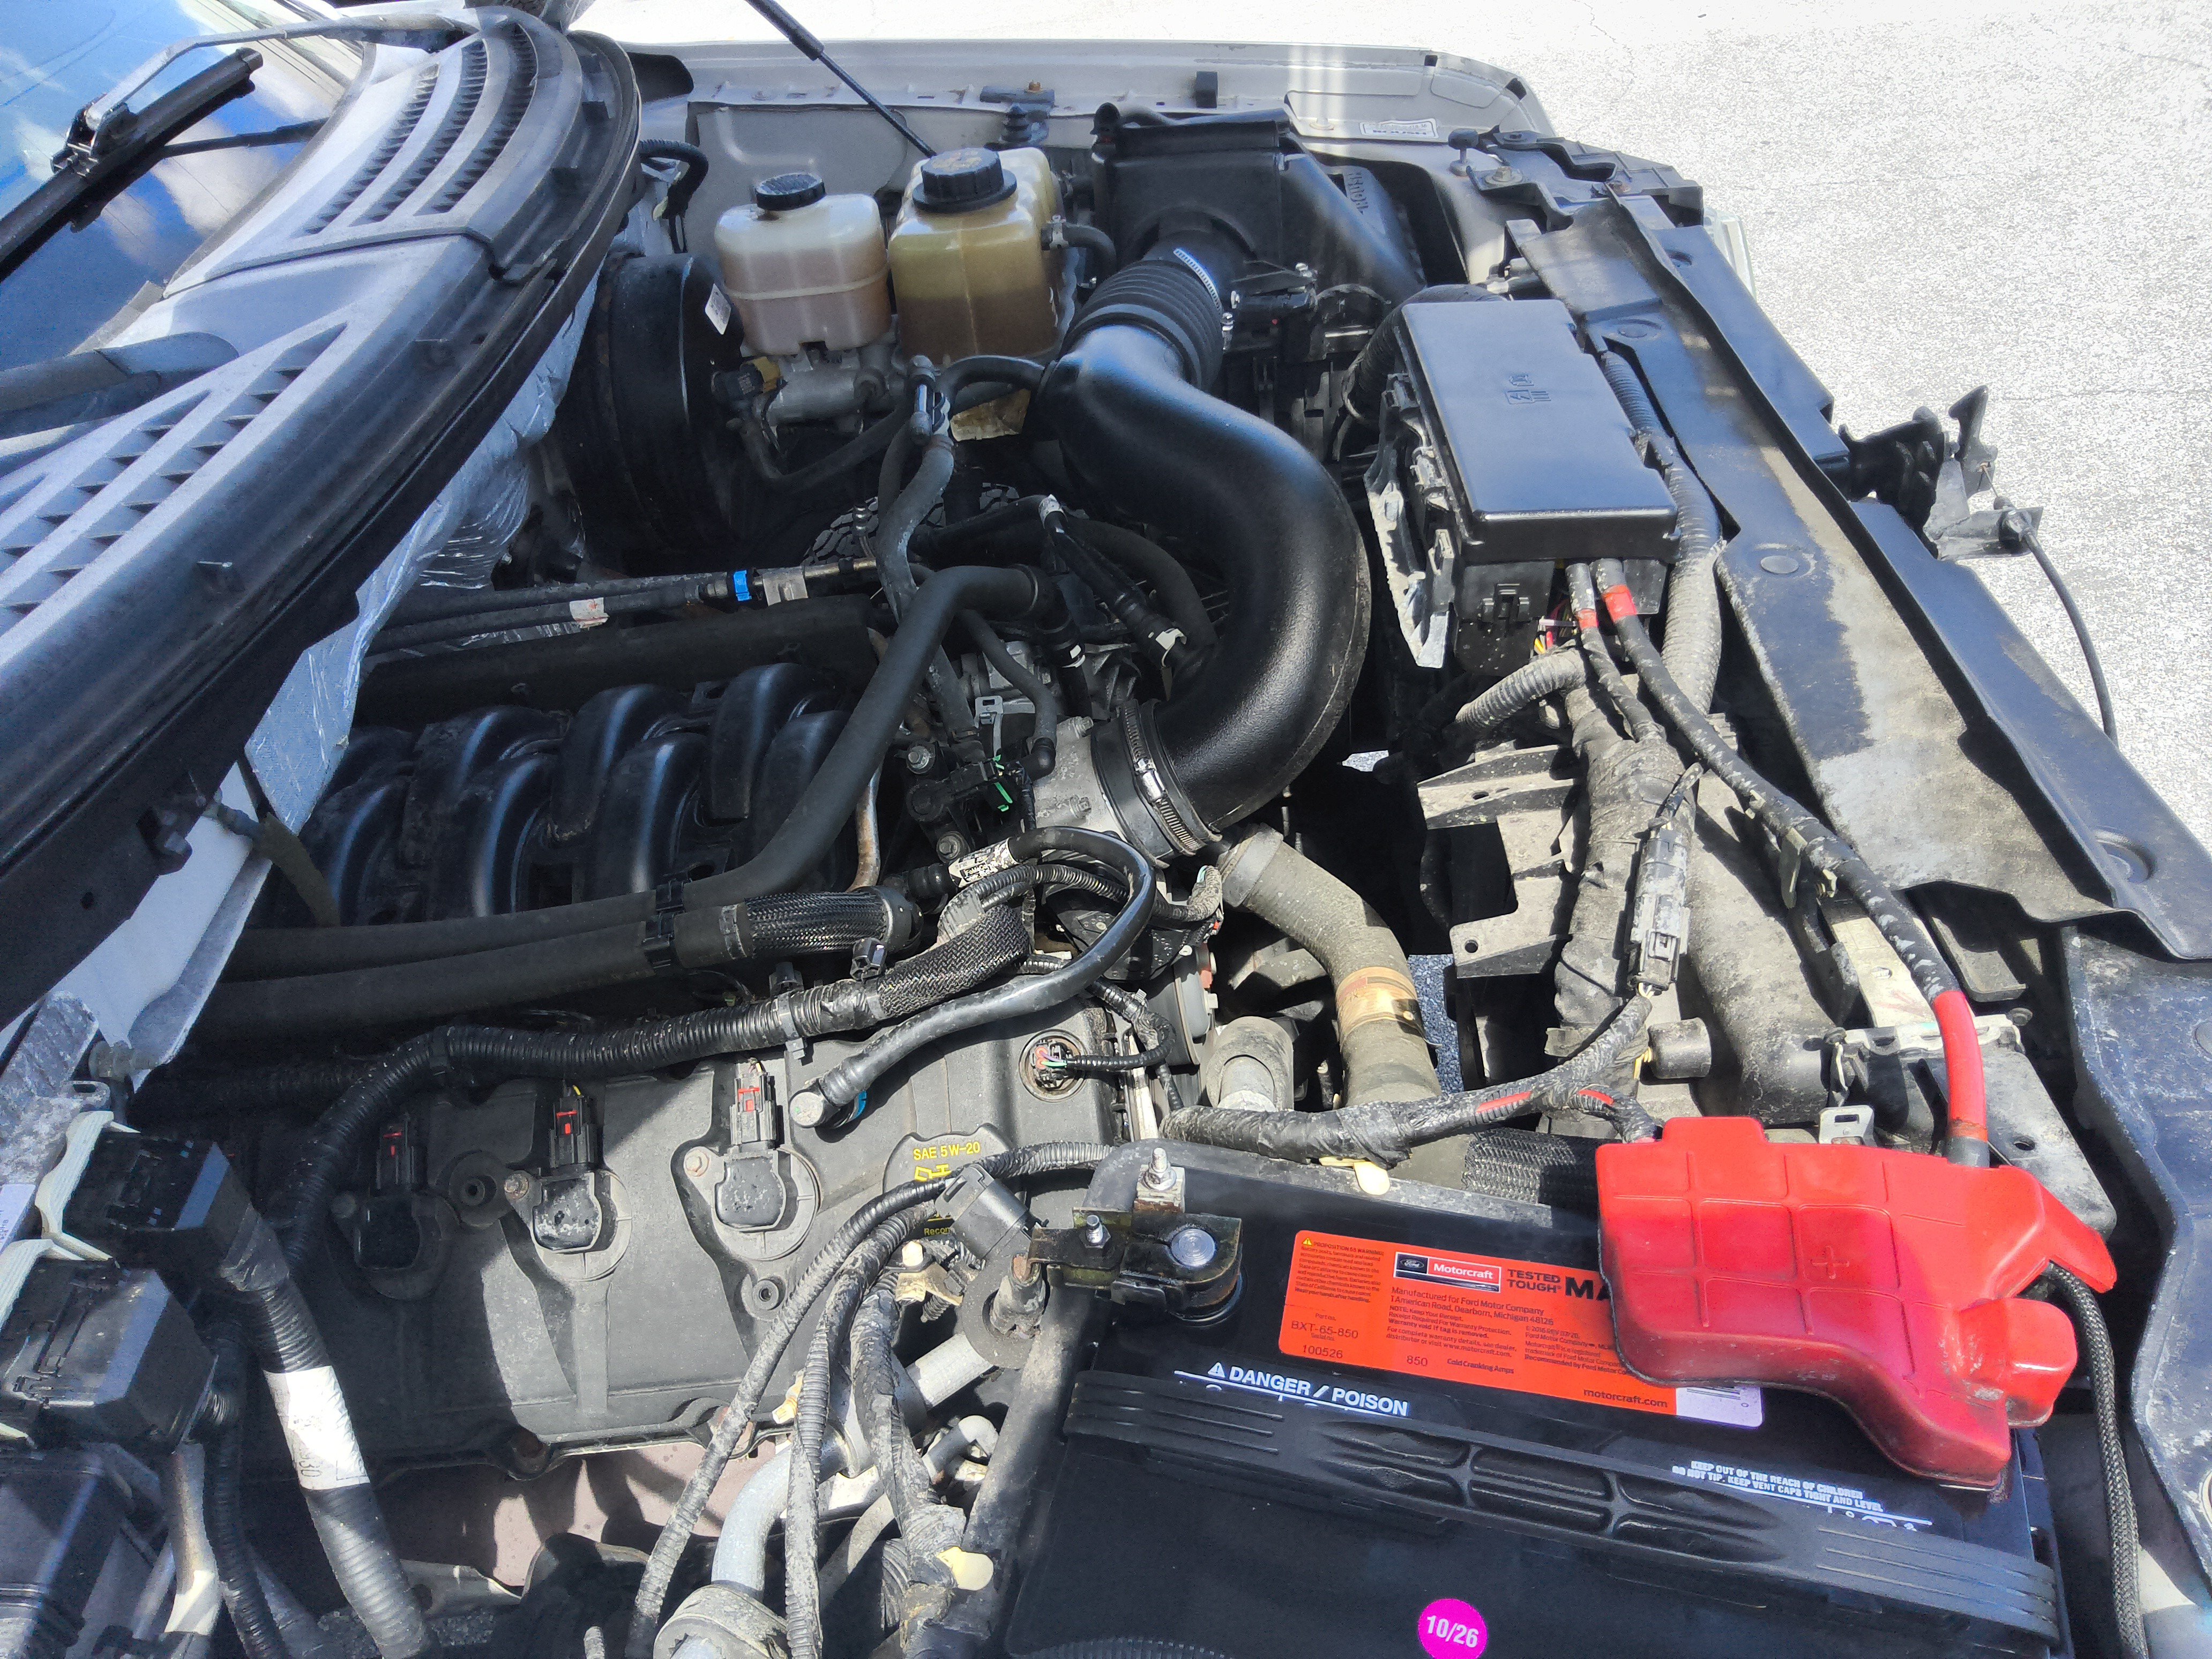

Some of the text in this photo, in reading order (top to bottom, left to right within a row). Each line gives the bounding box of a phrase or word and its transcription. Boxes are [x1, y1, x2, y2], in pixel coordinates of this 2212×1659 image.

[913, 1141, 981, 1161] SAE 5W-20
[1433, 1263, 1493, 1280] Motorcraft
[1507, 1268, 1561, 1283] TESTED
[1392, 1286, 1545, 1317] Manufactured for Ford Motor Company
[1395, 1296, 1431, 1309] American
[1454, 1305, 1492, 1318] Dearborn,
[1493, 1310, 1529, 1322] Michigan
[1529, 1316, 1554, 1326] 48126
[1290, 1320, 1359, 1339] BXT-65-850
[1388, 1318, 1417, 1328] Warranty
[1449, 1321, 1478, 1331] Warranty
[1477, 1325, 1512, 1335] Protection.
[1428, 1333, 1457, 1343] warranty
[1303, 1344, 1343, 1359] 100526
[1406, 1355, 1428, 1367] 850
[1447, 1358, 1514, 1374] Cold Cranking Amps
[1229, 1366, 1409, 1417] DANGER / POISON
[1583, 1388, 1668, 1408] motorcraft.com
[1687, 1468, 1706, 1480] NOT
[1728, 1476, 1751, 1487] KEEP
[1752, 1481, 1776, 1492] VENT
[1777, 1485, 1802, 1497] CAPS
[1803, 1490, 1832, 1503] TIGHT
[1833, 1494, 1853, 1506] AND
[1691, 1460, 1863, 1500] KEEP OUT OF THE REACH OF CHILDREN
[1426, 1615, 1479, 1648] 10/26
